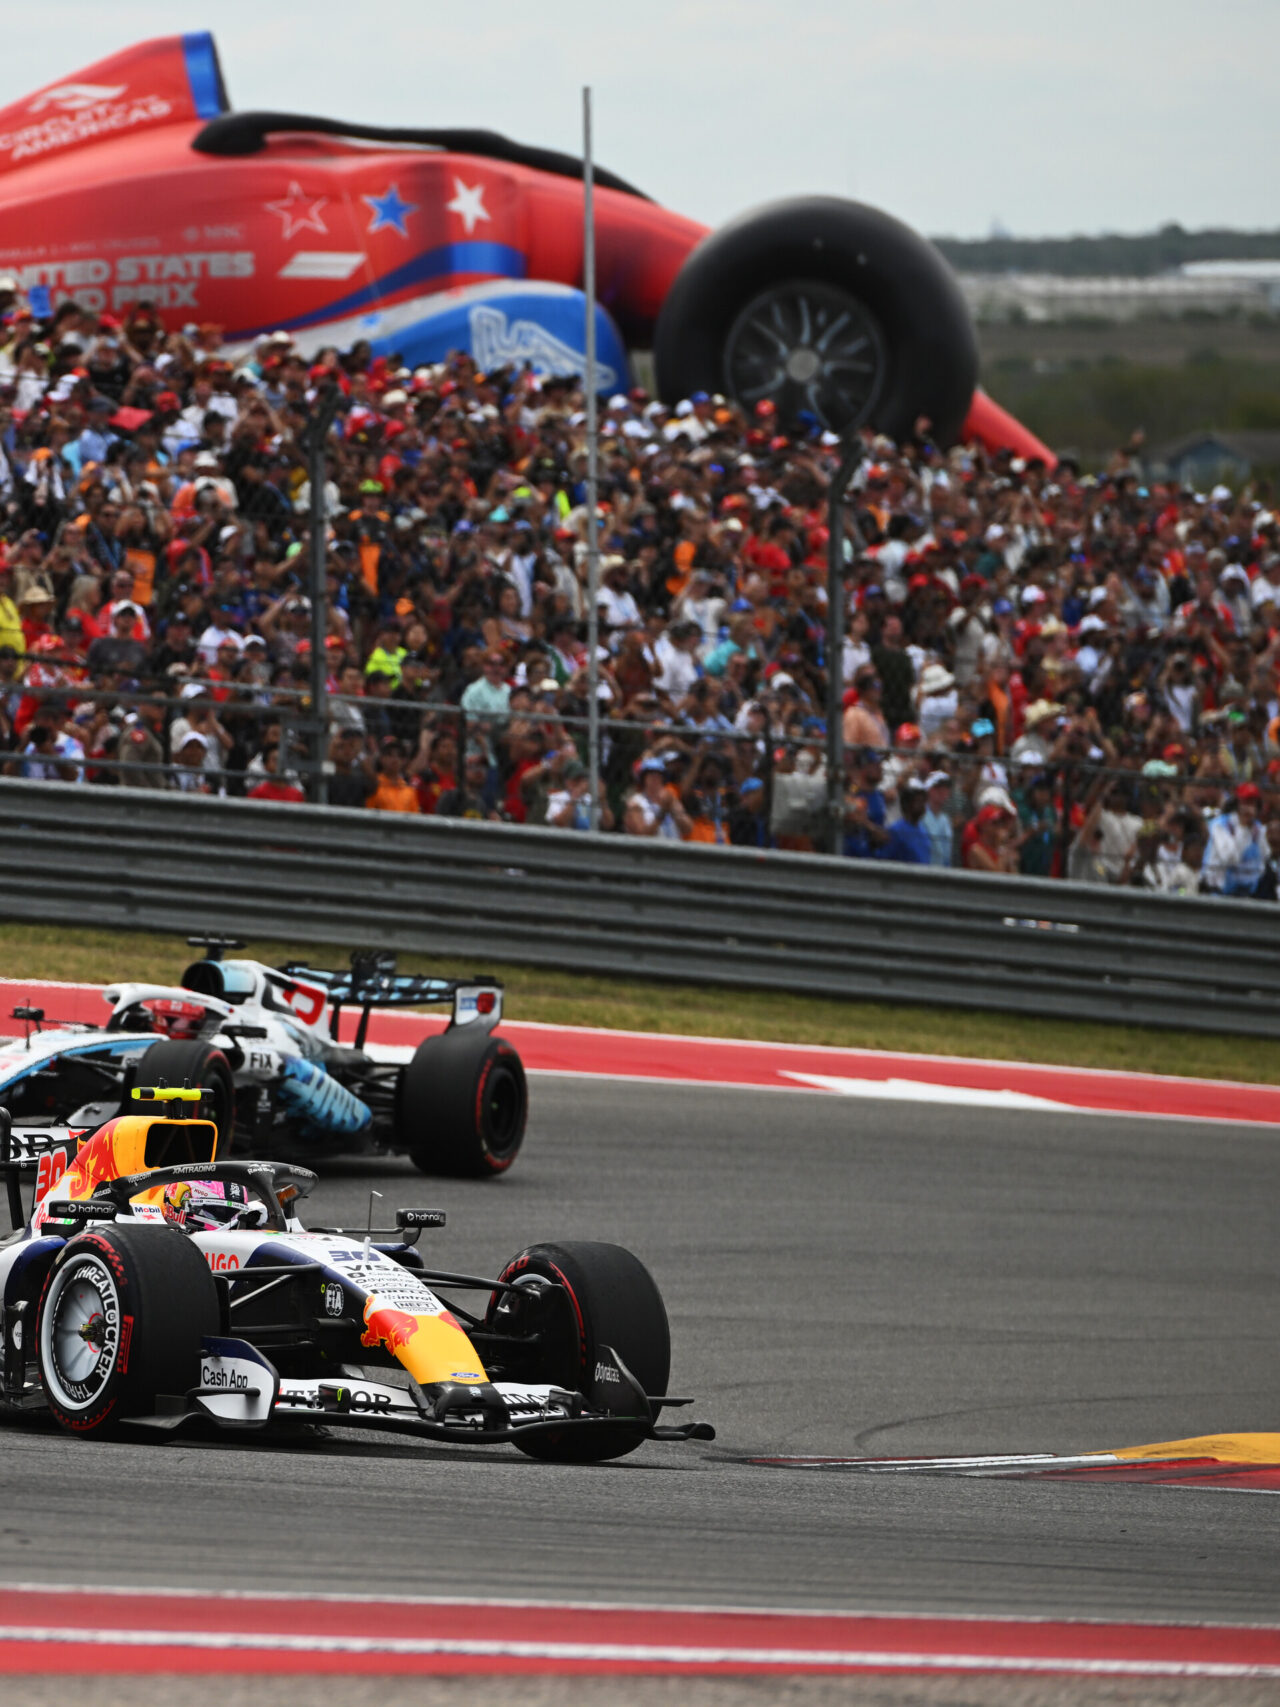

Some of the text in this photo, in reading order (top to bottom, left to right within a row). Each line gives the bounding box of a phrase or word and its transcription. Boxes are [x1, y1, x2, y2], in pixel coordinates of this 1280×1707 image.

[116, 251, 255, 282] STATES
[111, 281, 198, 310] PRIX
[205, 1252, 239, 1271] UGO
[202, 1366, 249, 1389] Cash App
[286, 1389, 392, 1416] TUOR
